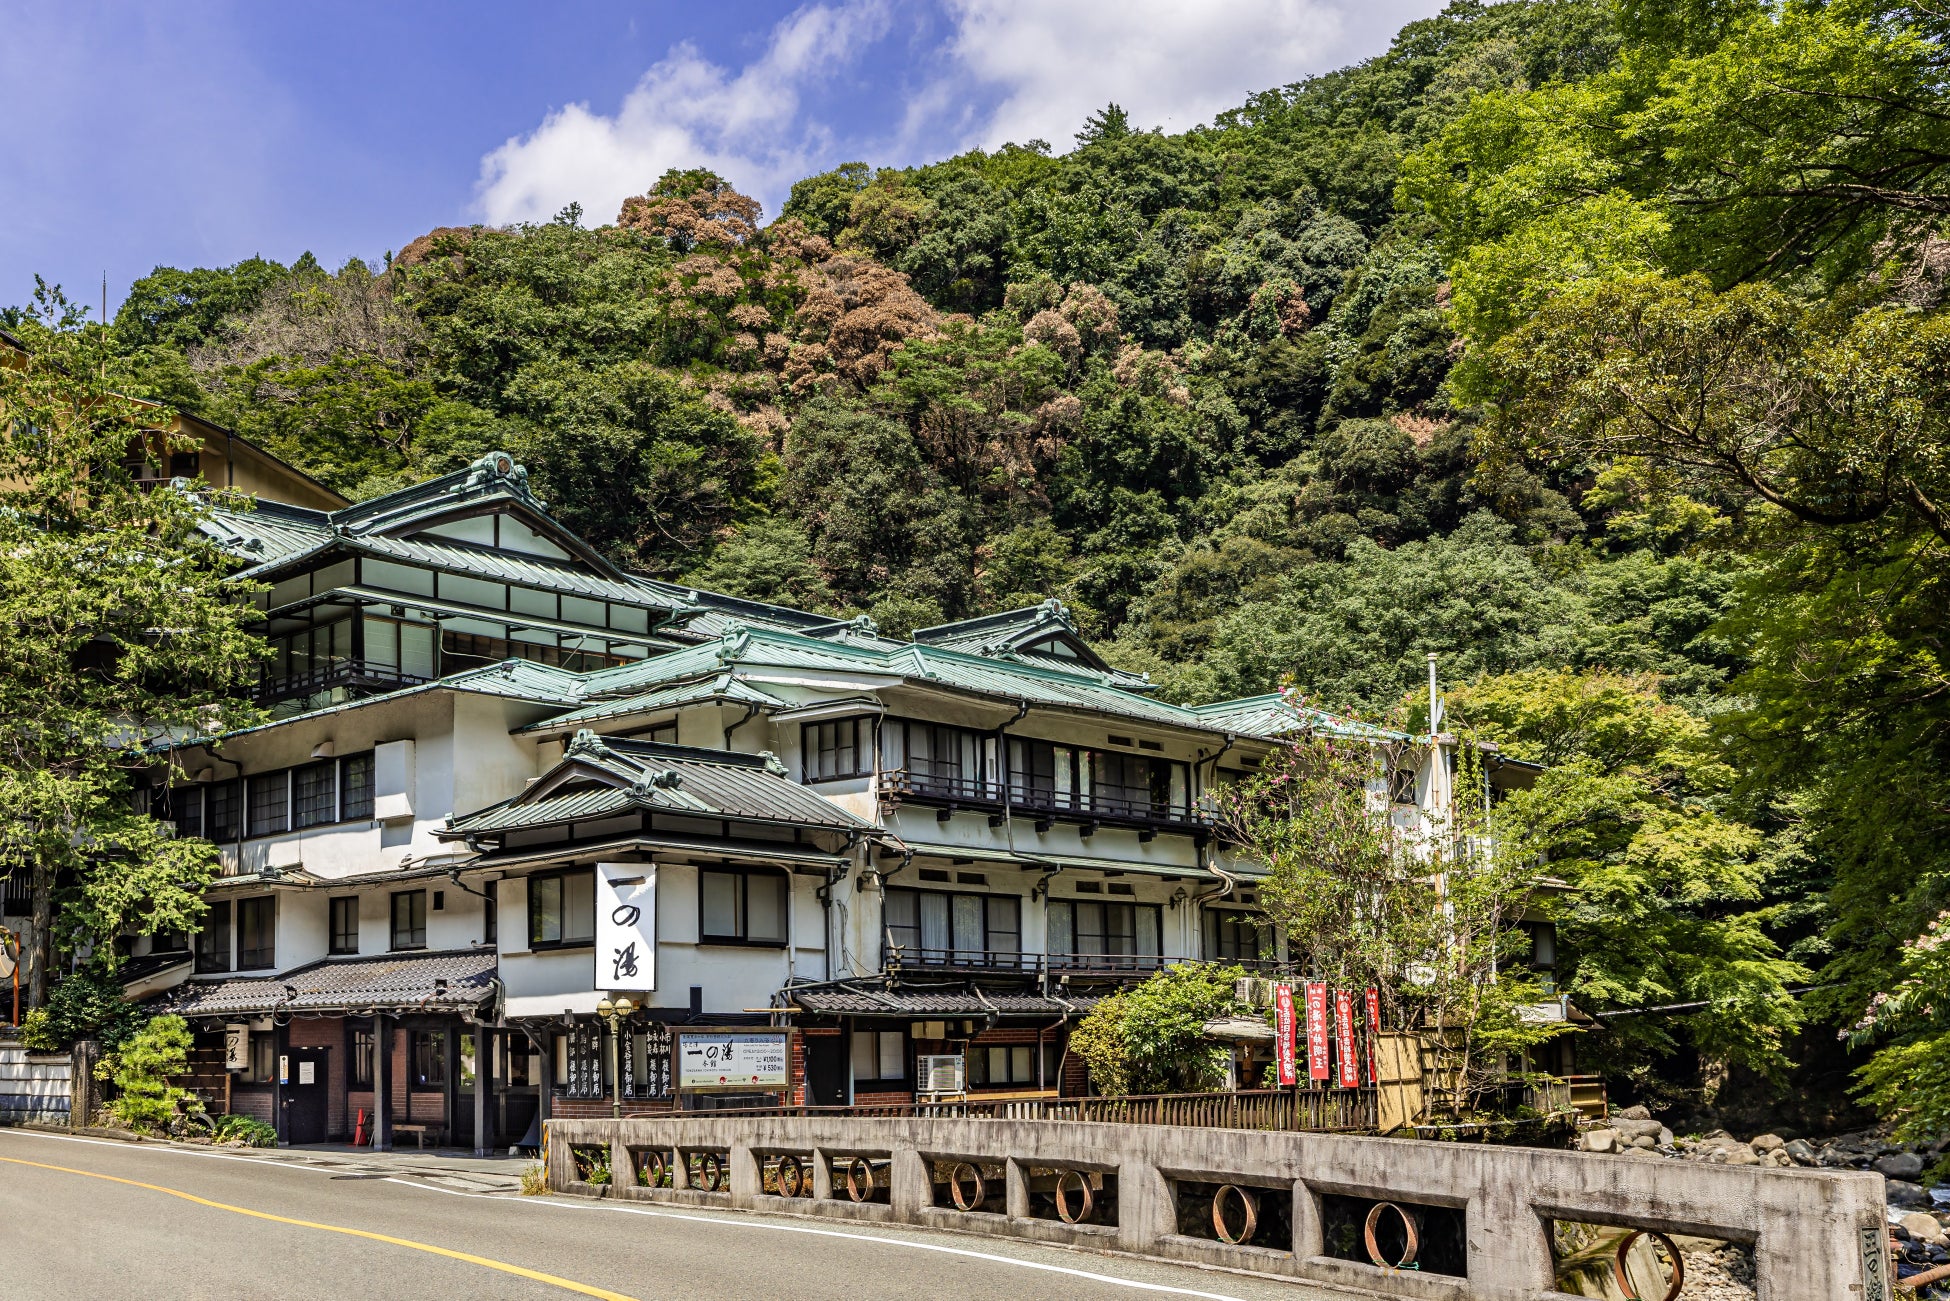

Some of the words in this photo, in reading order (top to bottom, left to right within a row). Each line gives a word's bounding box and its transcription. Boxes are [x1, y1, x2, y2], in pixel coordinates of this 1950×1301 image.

[607, 875, 647, 981] 一の湯
[226, 1029, 240, 1063] 一の湯
[687, 1038, 734, 1062] 一の湯
